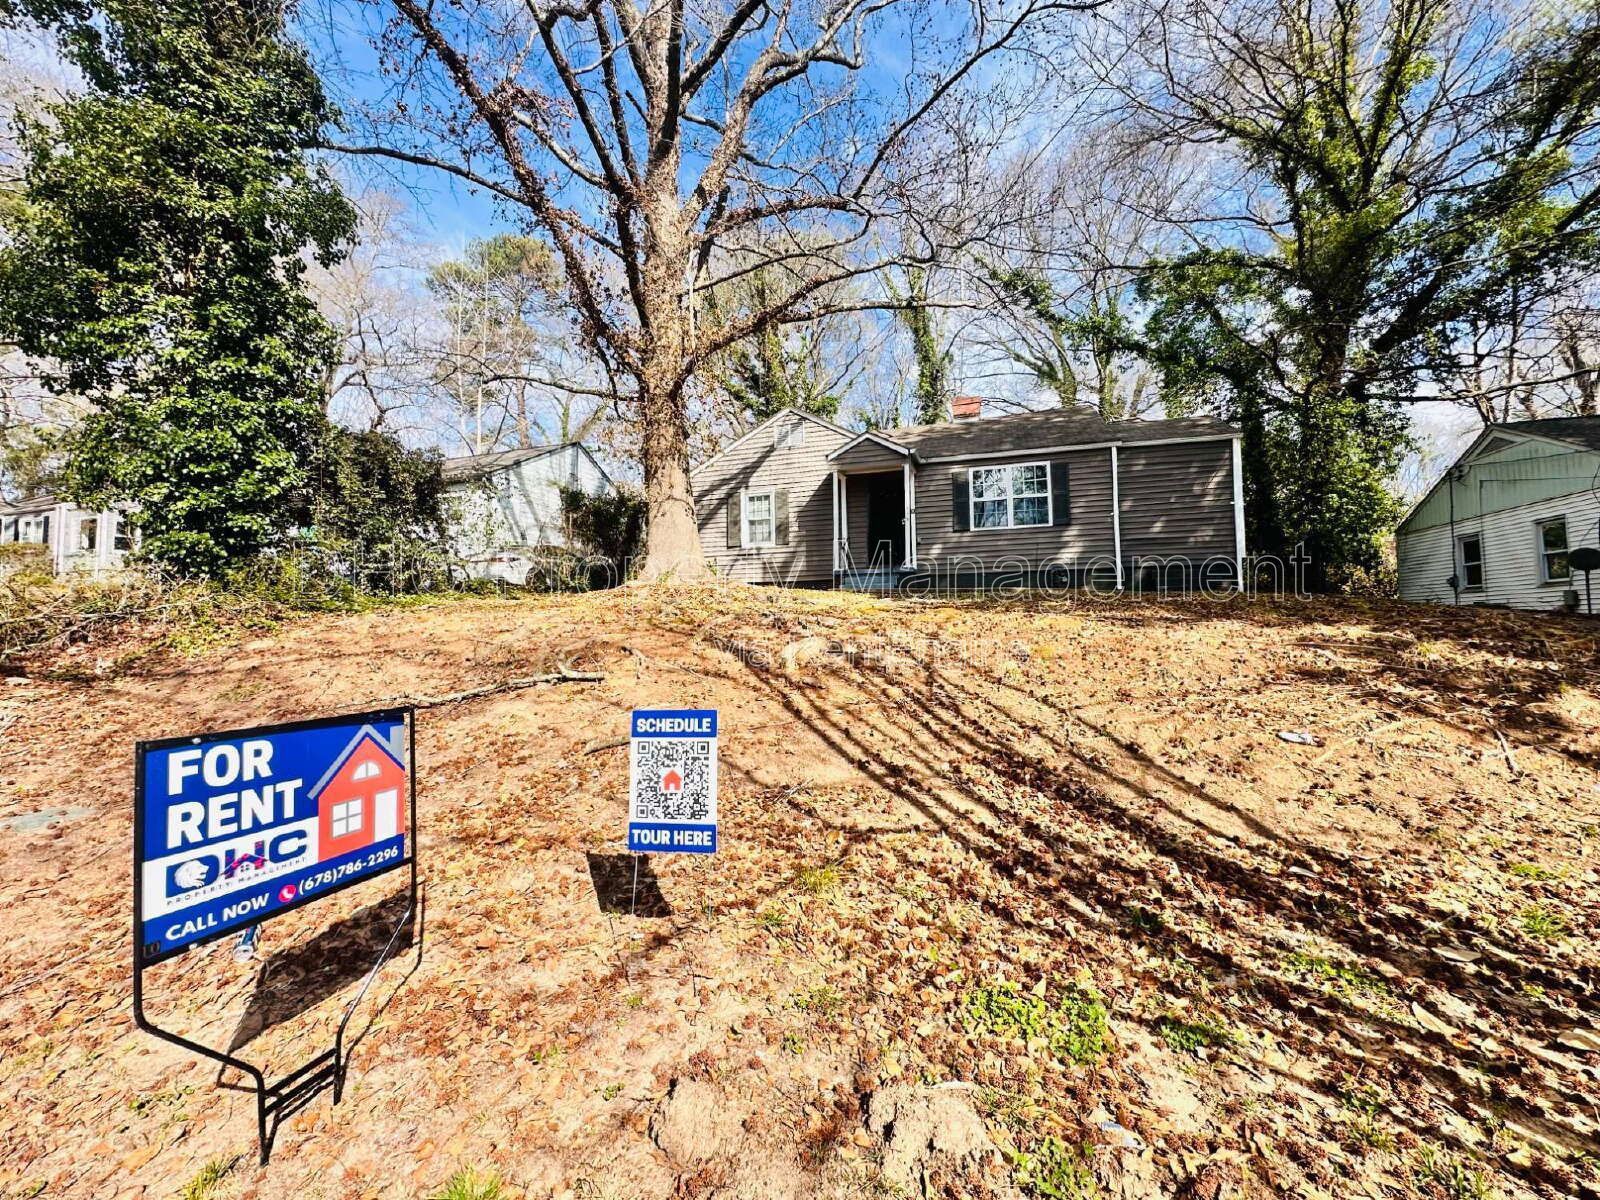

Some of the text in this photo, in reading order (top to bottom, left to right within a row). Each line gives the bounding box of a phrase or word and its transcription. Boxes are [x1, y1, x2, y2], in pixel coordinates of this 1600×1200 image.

[636, 717, 712, 733] SCHEDULE
[168, 739, 274, 796] FOR
[166, 778, 303, 850] RENT
[631, 829, 713, 846] TOUR HERE
[165, 845, 399, 941] CALL NOW (678)786-2296
[166, 857, 306, 906] PROPERTY MANAGEMENT
